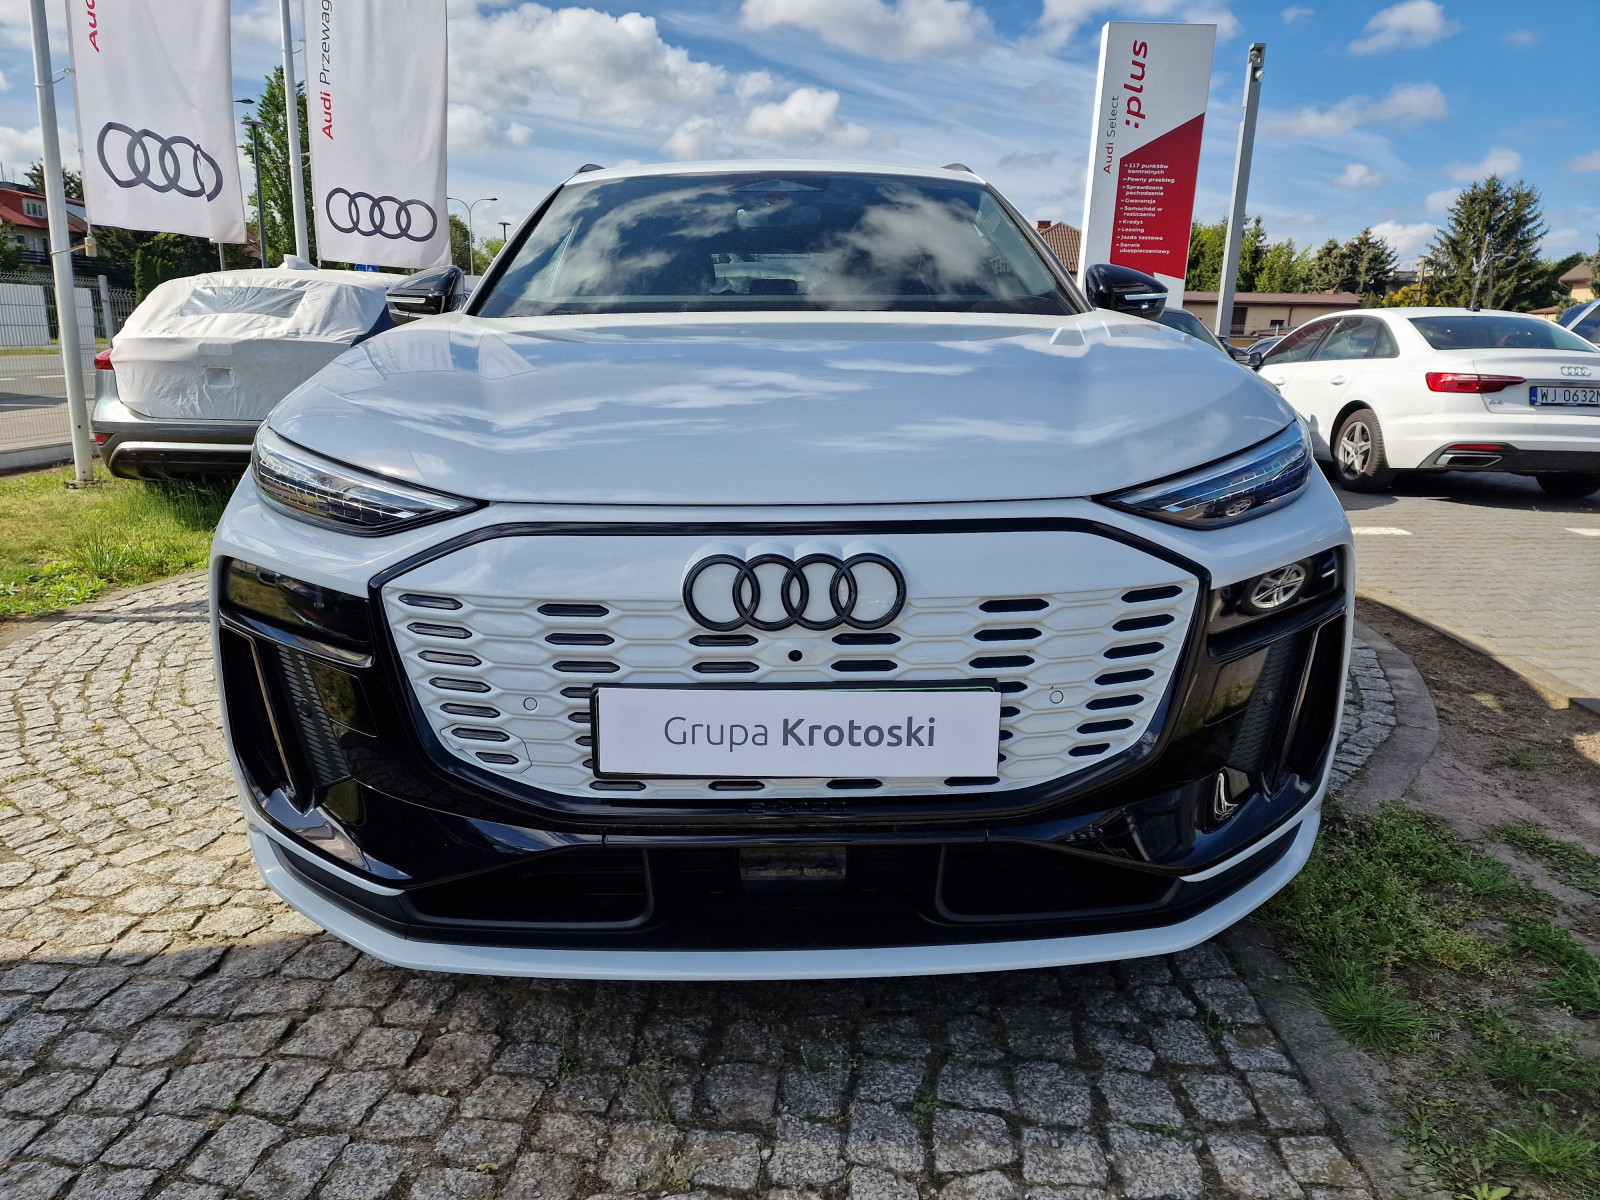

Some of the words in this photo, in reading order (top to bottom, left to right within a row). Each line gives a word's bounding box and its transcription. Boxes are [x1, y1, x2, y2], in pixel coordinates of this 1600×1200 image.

[1124, 40, 1148, 128] :plus
[319, 91, 334, 140] Audi
[1106, 96, 1120, 138] Select
[1103, 142, 1114, 174] Audi
[1540, 389, 1557, 402] WJ
[664, 716, 768, 752] Grupa
[782, 716, 936, 747] Krotoski
